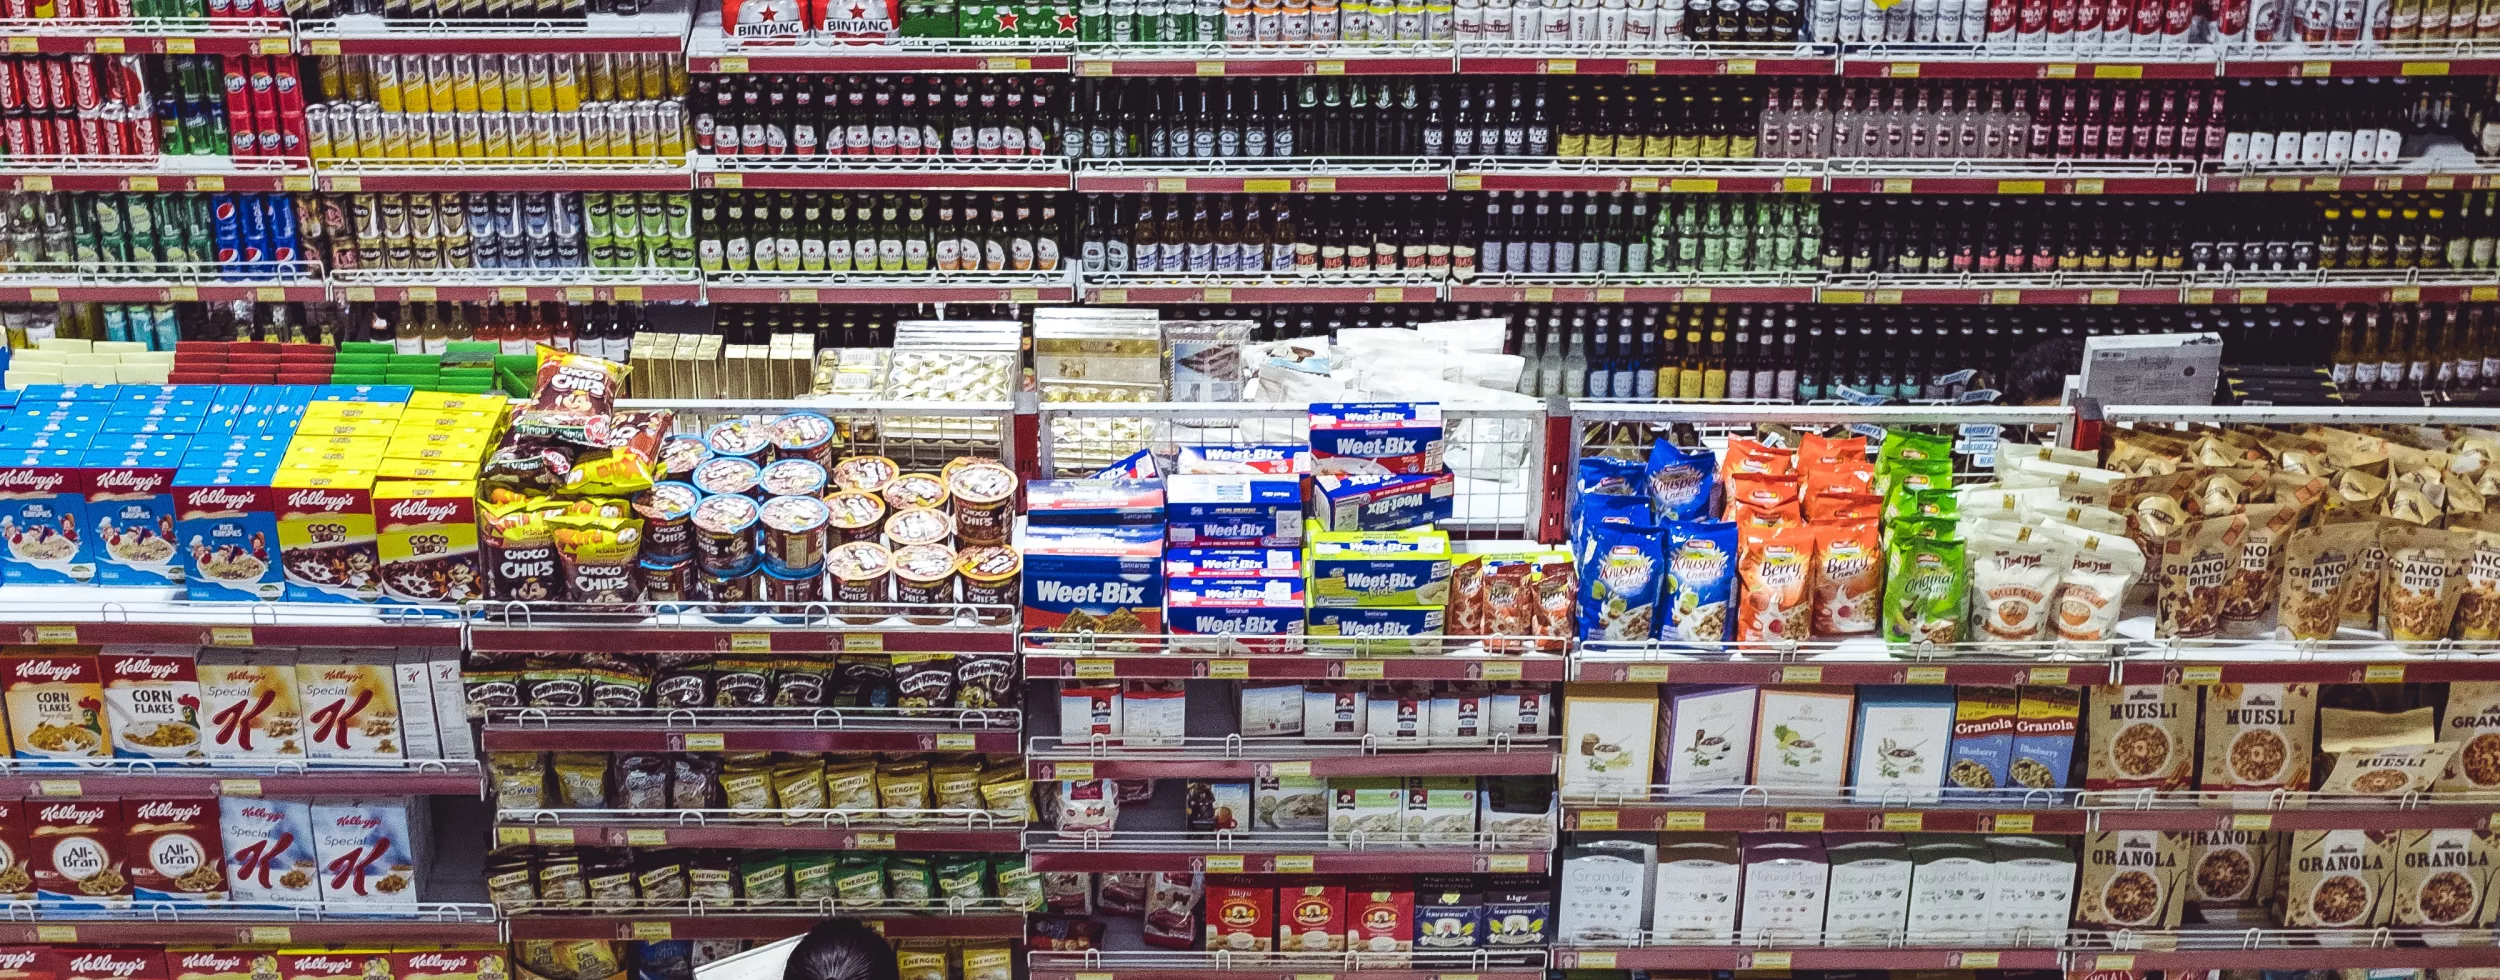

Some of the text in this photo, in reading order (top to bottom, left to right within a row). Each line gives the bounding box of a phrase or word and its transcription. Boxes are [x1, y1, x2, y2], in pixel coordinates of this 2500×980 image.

[738, 22, 799, 36] BINTANG
[828, 20, 889, 33] BINTANG
[559, 366, 604, 380] CHOCO
[551, 374, 605, 396] CHIPS
[1337, 437, 1417, 454] Weet-Bix
[1205, 448, 1285, 461] Weet-Bix
[0, 469, 63, 490] Kellogg's
[97, 470, 162, 490] Kellogg's
[188, 488, 255, 509] Kellogg's
[288, 489, 354, 509] Kellogg's
[390, 500, 458, 521] Kellogg's
[308, 523, 347, 535] COCO
[1203, 524, 1265, 536] Weet-Bix
[409, 534, 449, 546] COCO
[504, 549, 549, 560] CHOCO
[500, 561, 554, 579] CHIPS
[578, 566, 622, 577] CHOCO
[1600, 562, 1651, 580] Knusper
[1672, 556, 1726, 571] Knusper
[1762, 562, 1801, 579] Berry
[1827, 555, 1868, 574] Berry
[2388, 558, 2463, 578] GRANOLA
[576, 576, 629, 592] CHIPS
[1347, 573, 1417, 588] Weet-Bix
[1904, 574, 1955, 593] Original
[2404, 576, 2441, 588] BITES
[1037, 580, 1145, 604] Weet-Bix
[1195, 616, 1278, 633] Weet-Bix
[1342, 621, 1411, 635] Weet-Bix
[16, 659, 81, 681] Kellogg's
[115, 658, 180, 678] Kellogg's
[36, 692, 70, 704] CORN
[132, 689, 173, 703] CORN
[208, 686, 250, 698] Special
[306, 685, 348, 697] Special
[38, 702, 72, 714] FLAKES
[134, 703, 175, 714] FLAKES
[2109, 703, 2178, 720] MUESLI
[212, 689, 277, 751] K
[310, 687, 374, 750] K
[2226, 709, 2296, 725] MUESLI
[1955, 717, 2014, 735] Granola
[2016, 718, 2075, 734] Granola
[2356, 757, 2427, 769] MUESLI
[40, 804, 105, 824] Kellogg's
[138, 802, 201, 821] Kellogg's
[241, 806, 286, 821] Kellogg's
[336, 815, 382, 828] Kellogg's
[230, 826, 272, 838] Special
[324, 835, 367, 847] Special
[68, 846, 93, 859] All-
[166, 844, 190, 857] All-
[2093, 850, 2177, 868] GRANOLA
[62, 856, 98, 869] Bran
[159, 854, 195, 868] Bran
[234, 832, 295, 889] K
[328, 837, 390, 896] K
[2298, 854, 2384, 872] GRANOLA
[2404, 850, 2490, 869] GRANOLA
[71, 954, 146, 976] Kellogg's
[182, 953, 240, 972] Kellogg's
[295, 955, 352, 973] Kellogg's
[409, 954, 467, 971] Kellogg's
